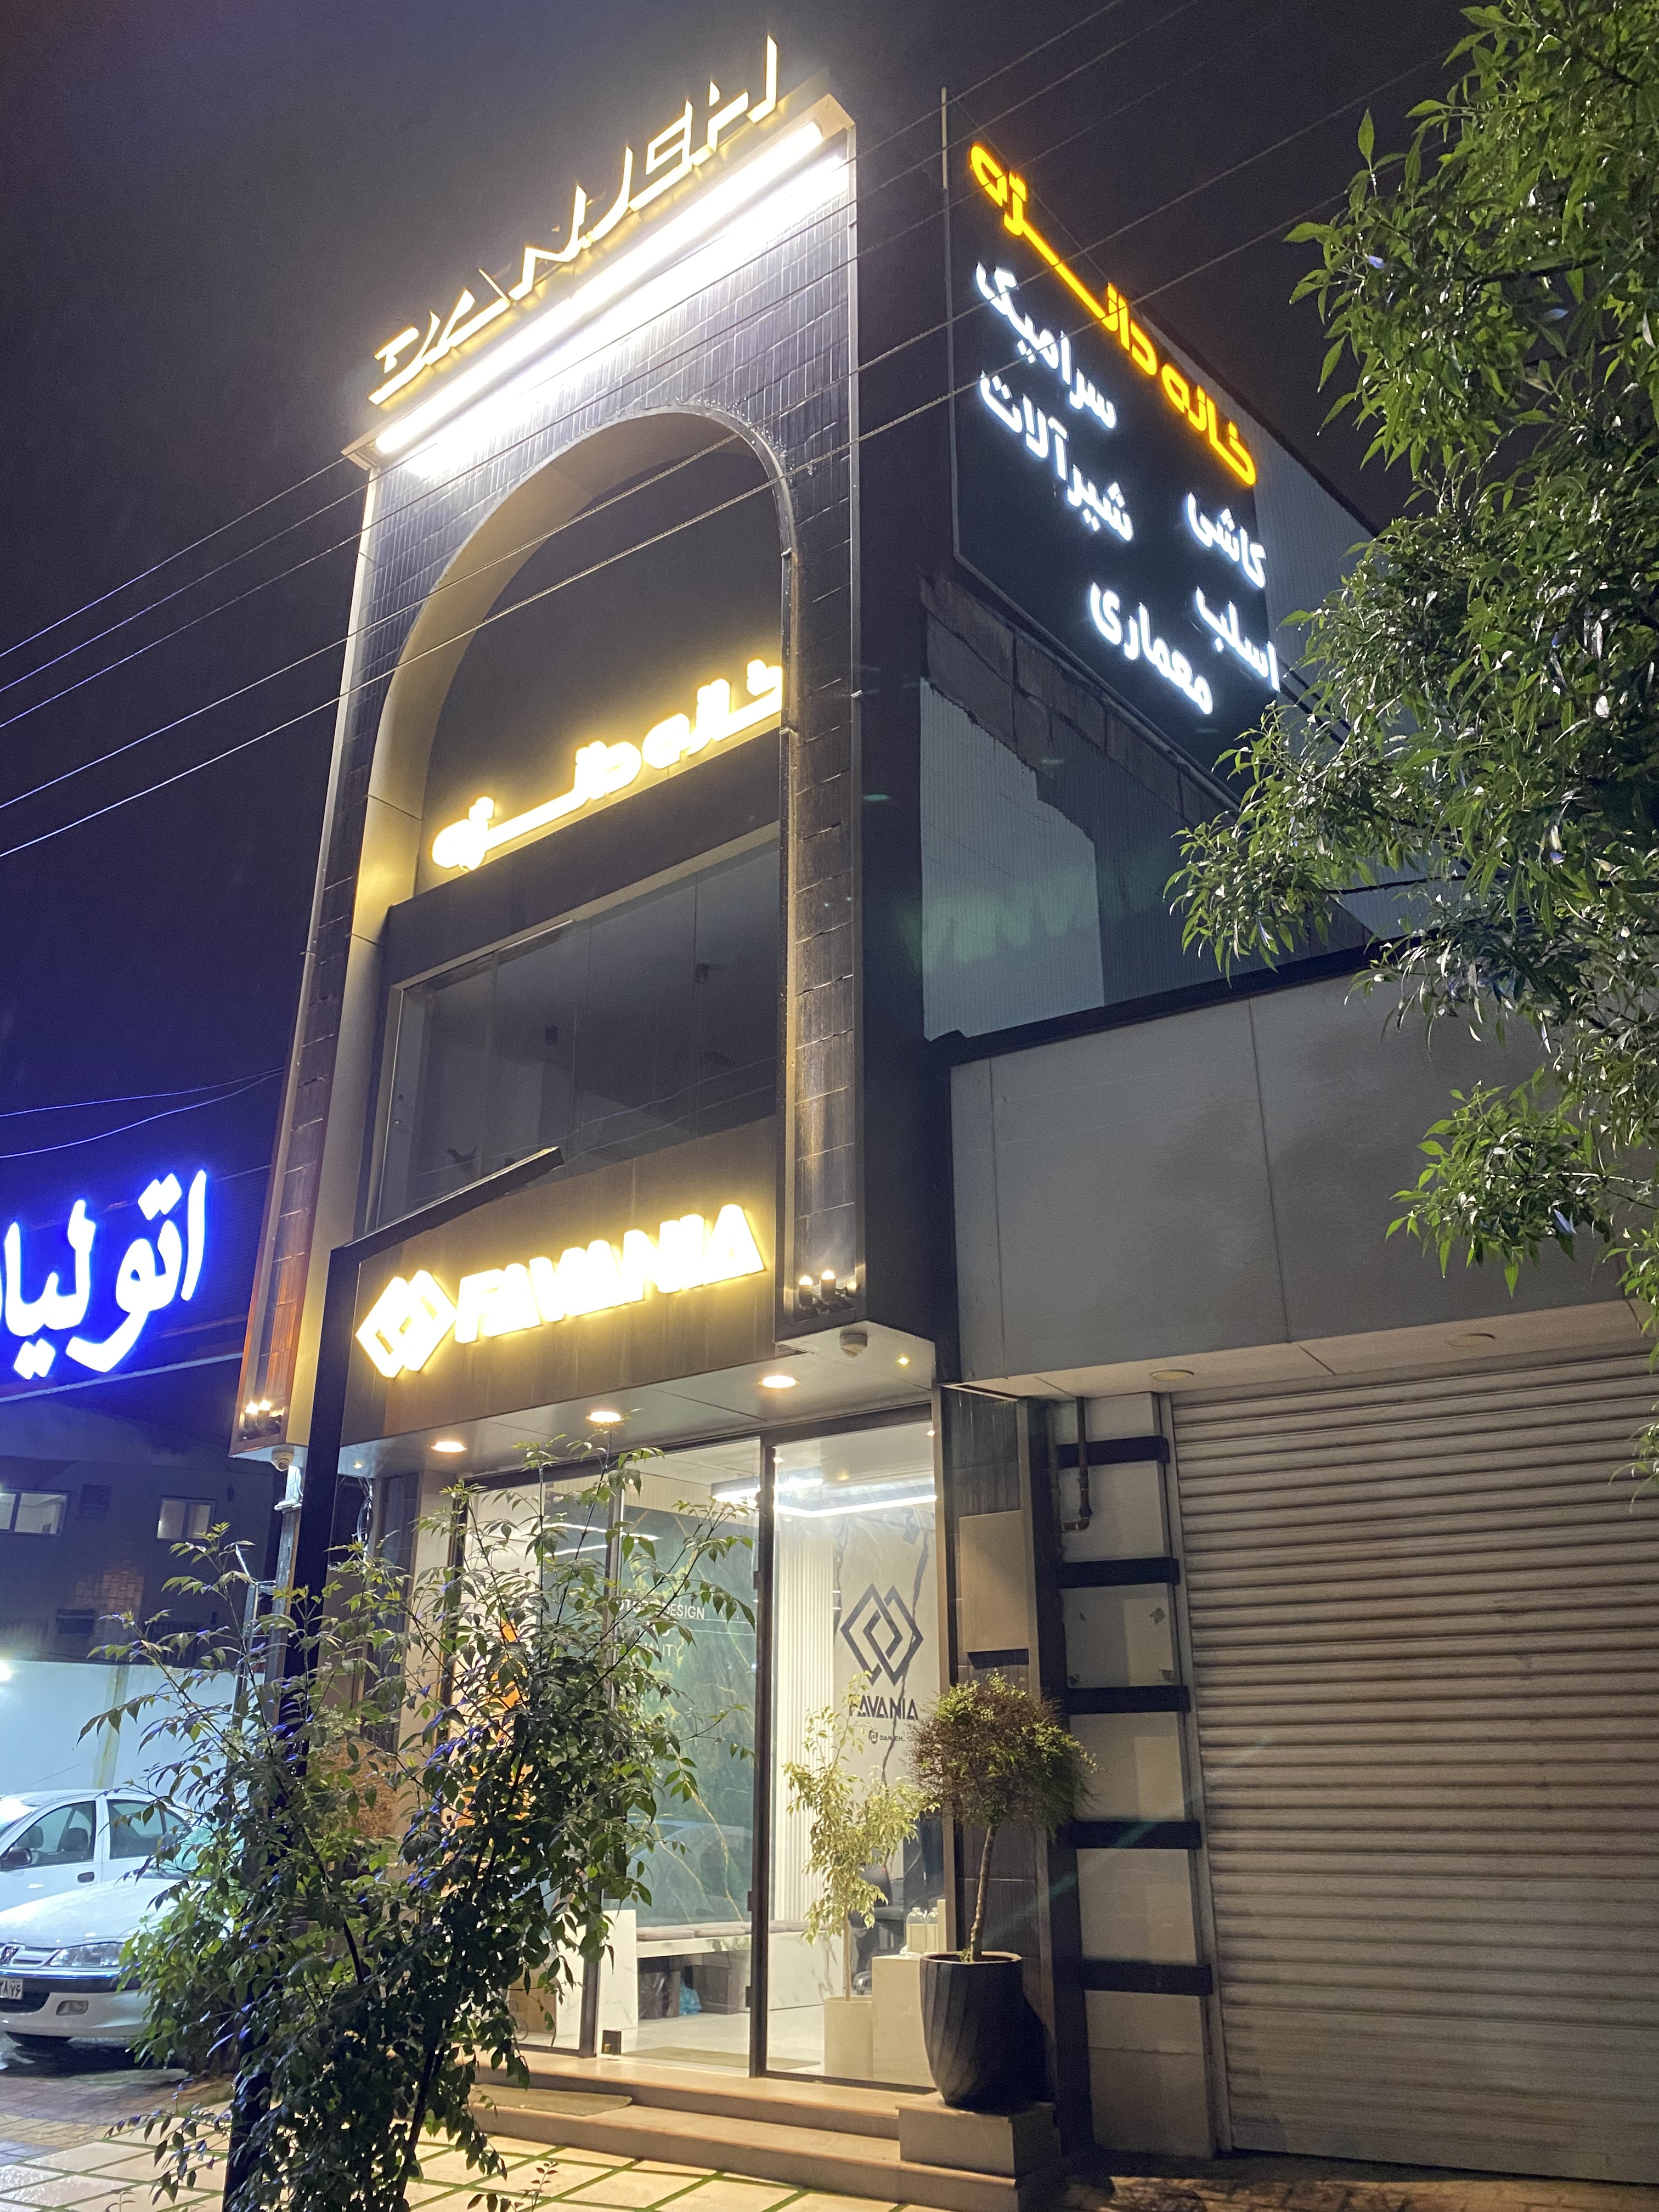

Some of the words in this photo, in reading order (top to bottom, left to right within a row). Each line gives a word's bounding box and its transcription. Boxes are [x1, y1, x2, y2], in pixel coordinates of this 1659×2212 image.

[1161, 363, 1257, 487] خانه
[1185, 492, 1267, 589] کاشی
[1090, 582, 1214, 715] معماری
[1195, 586, 1280, 692] اسلب
